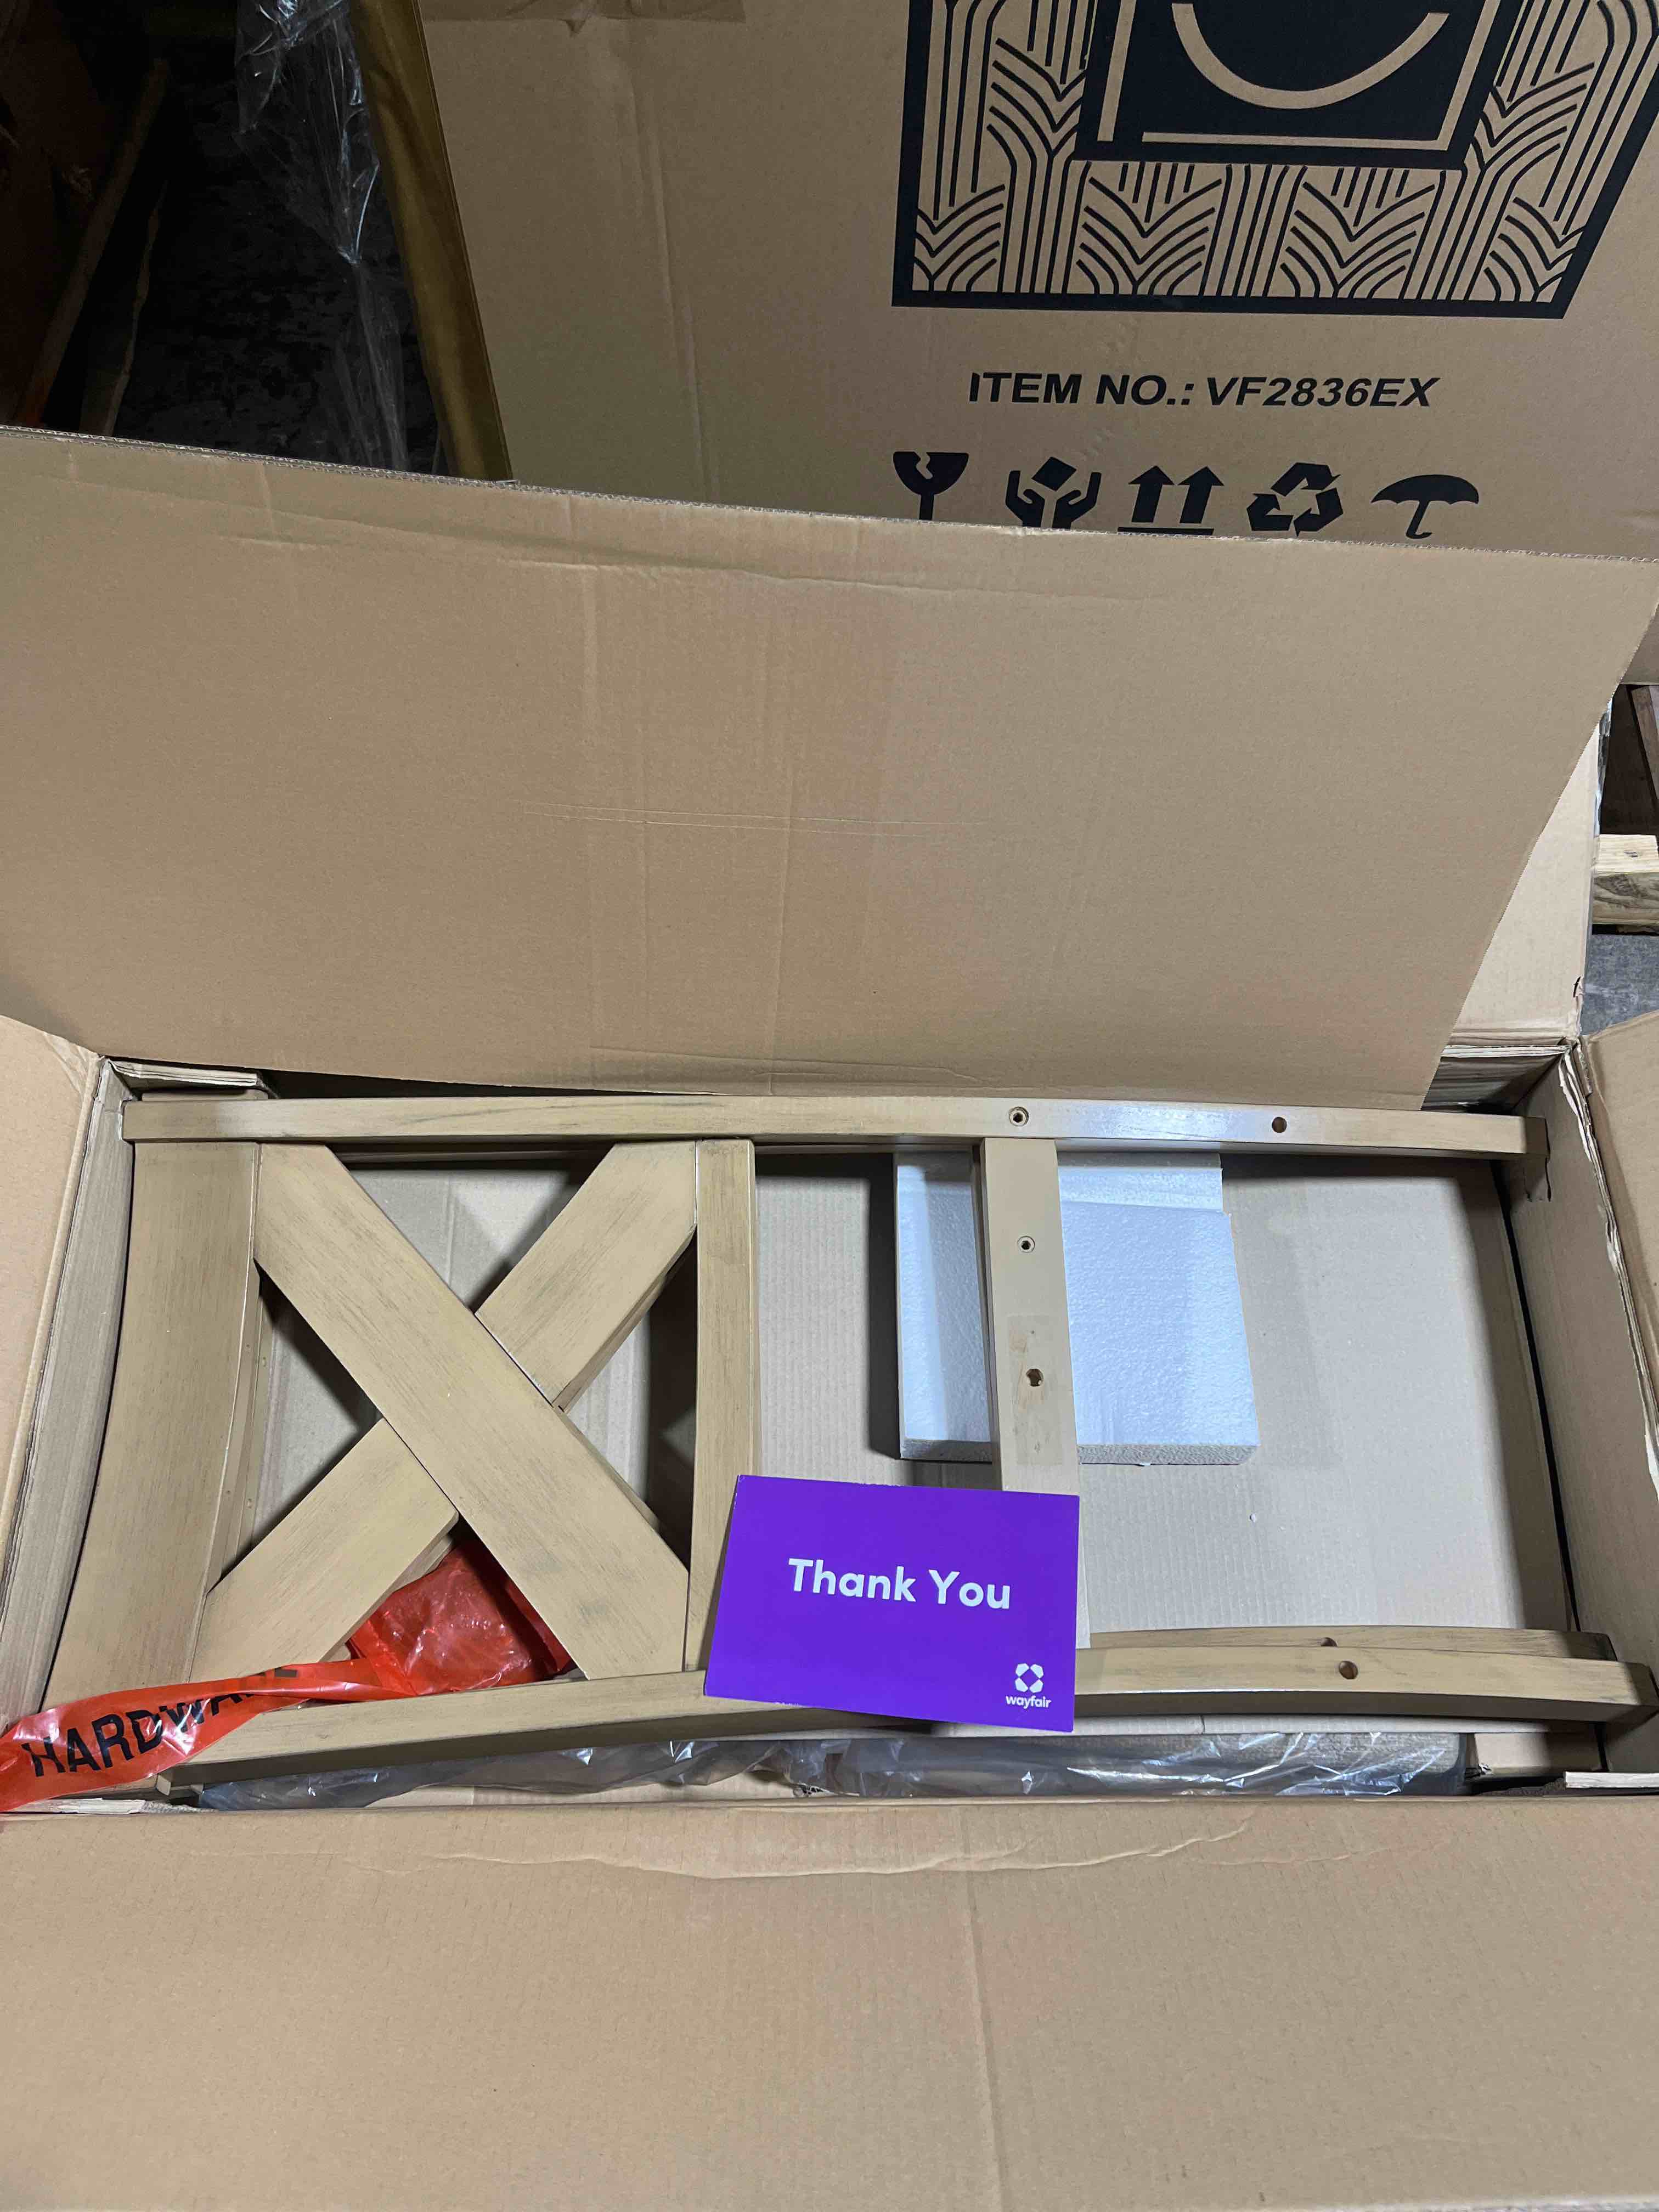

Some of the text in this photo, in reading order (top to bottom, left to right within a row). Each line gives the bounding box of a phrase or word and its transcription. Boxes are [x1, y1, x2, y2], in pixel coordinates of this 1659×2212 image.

[968, 371, 1441, 408] ITEM NO.: VF2836EX
[788, 1558, 1011, 1610] Thank You
[1005, 1694, 1052, 1710] wayfair
[20, 1692, 256, 1778] HARDW
